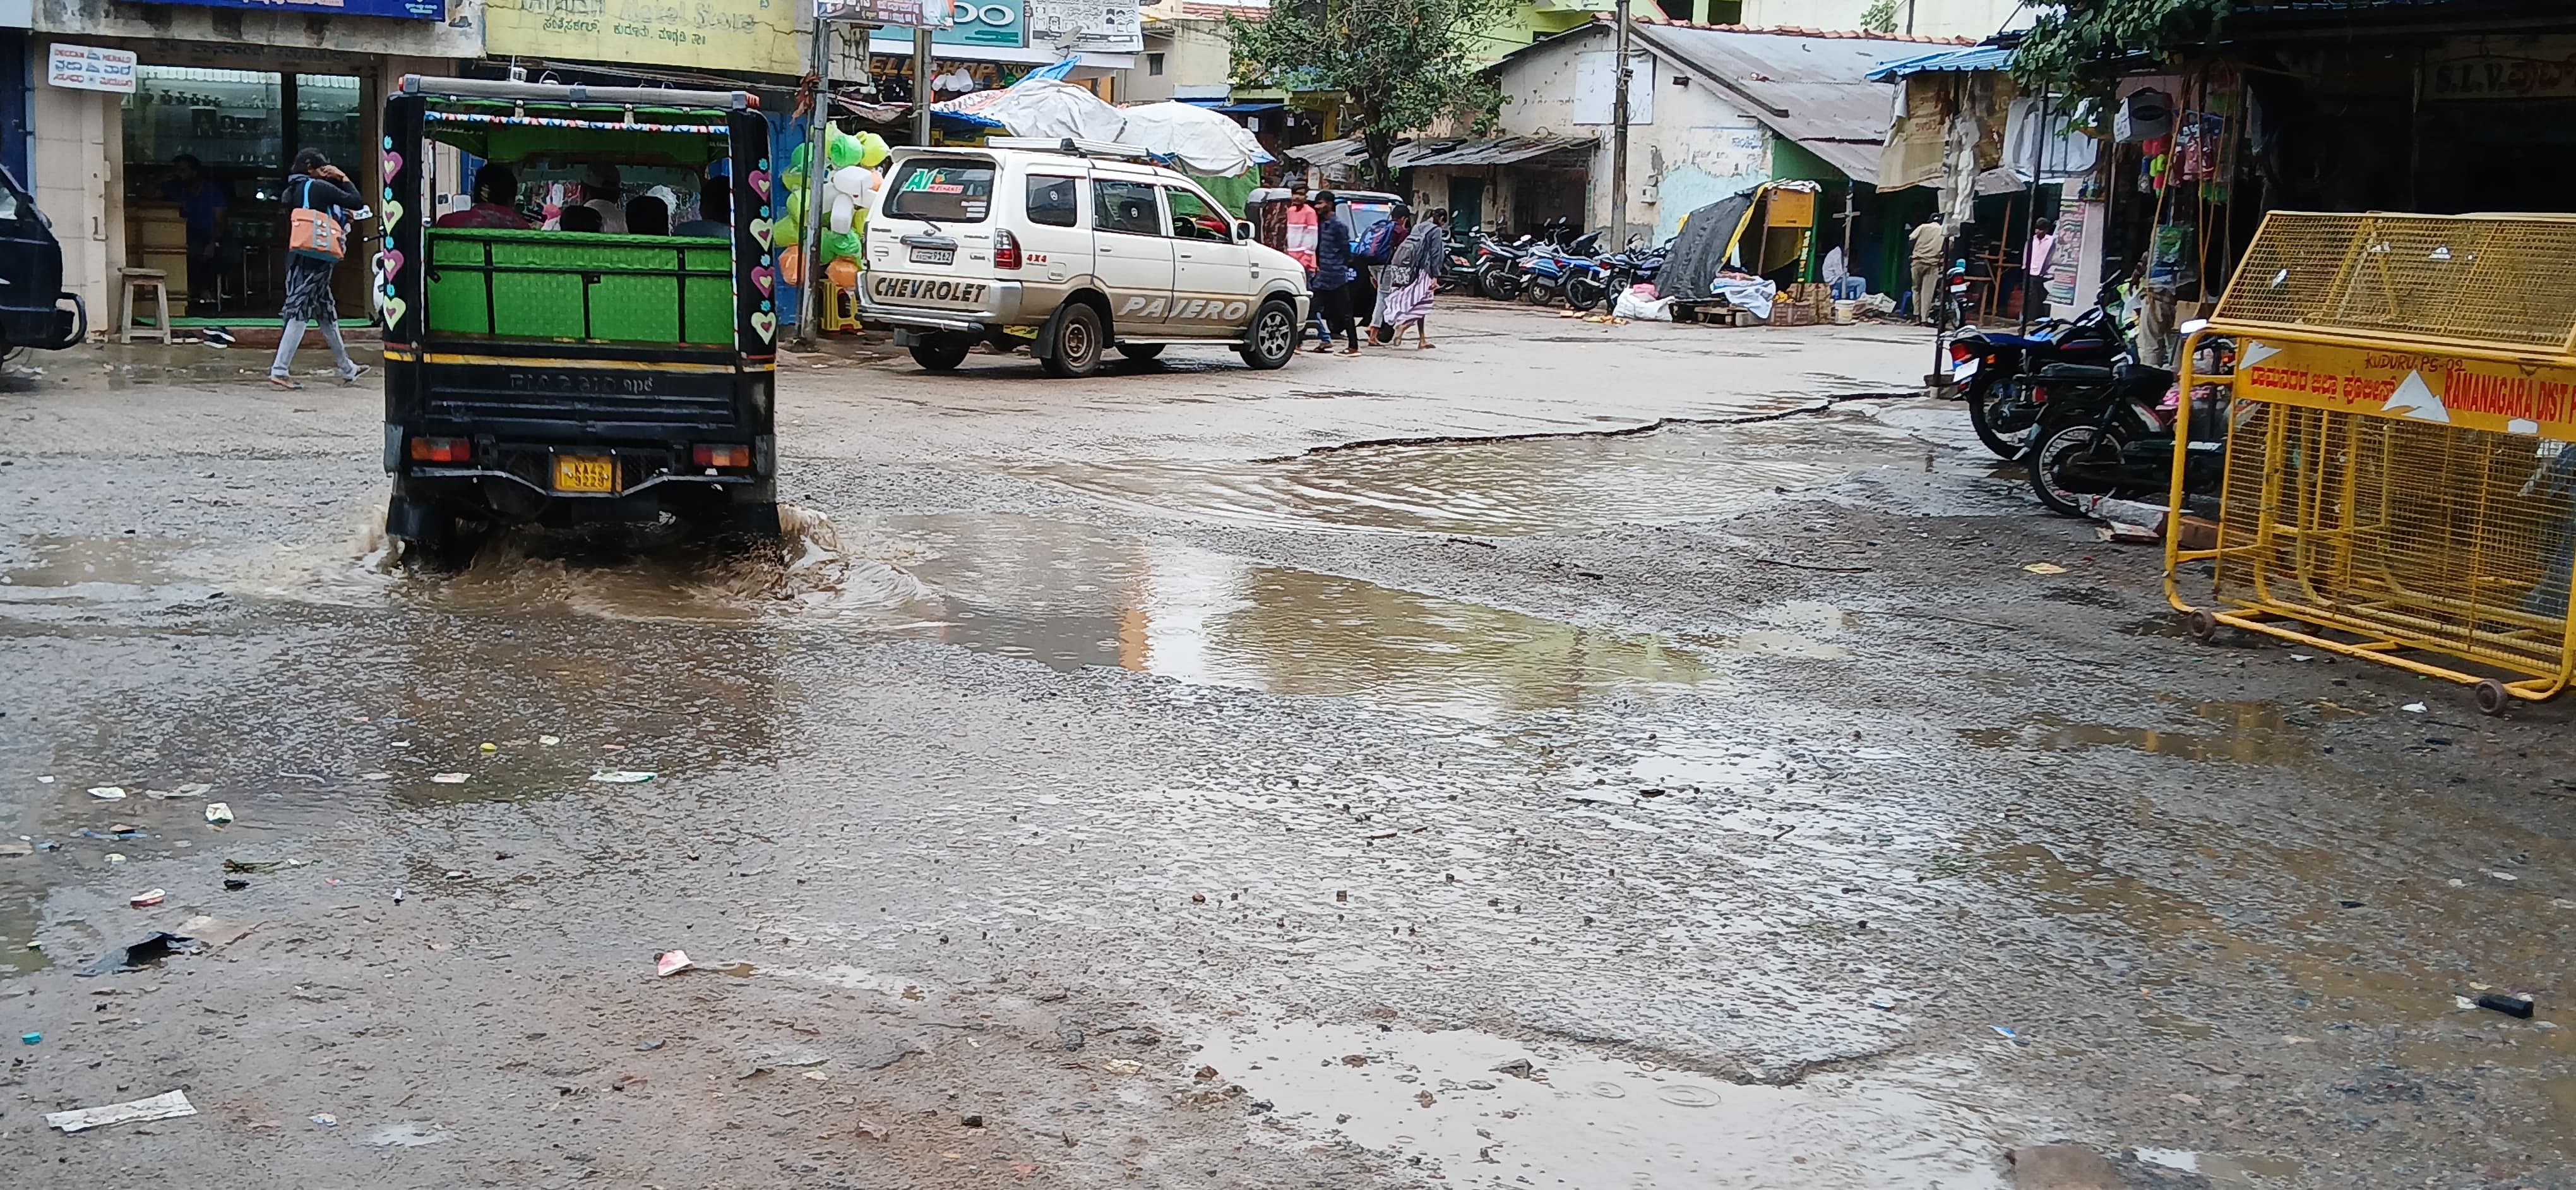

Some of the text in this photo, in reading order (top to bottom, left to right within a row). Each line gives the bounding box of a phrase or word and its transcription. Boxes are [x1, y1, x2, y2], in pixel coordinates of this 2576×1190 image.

[874, 277, 987, 303] CHEVROLET
[1117, 297, 1248, 320] PAJERO
[2443, 369, 2533, 418] RAMANAGARA
[2536, 380, 2568, 423] DIST
